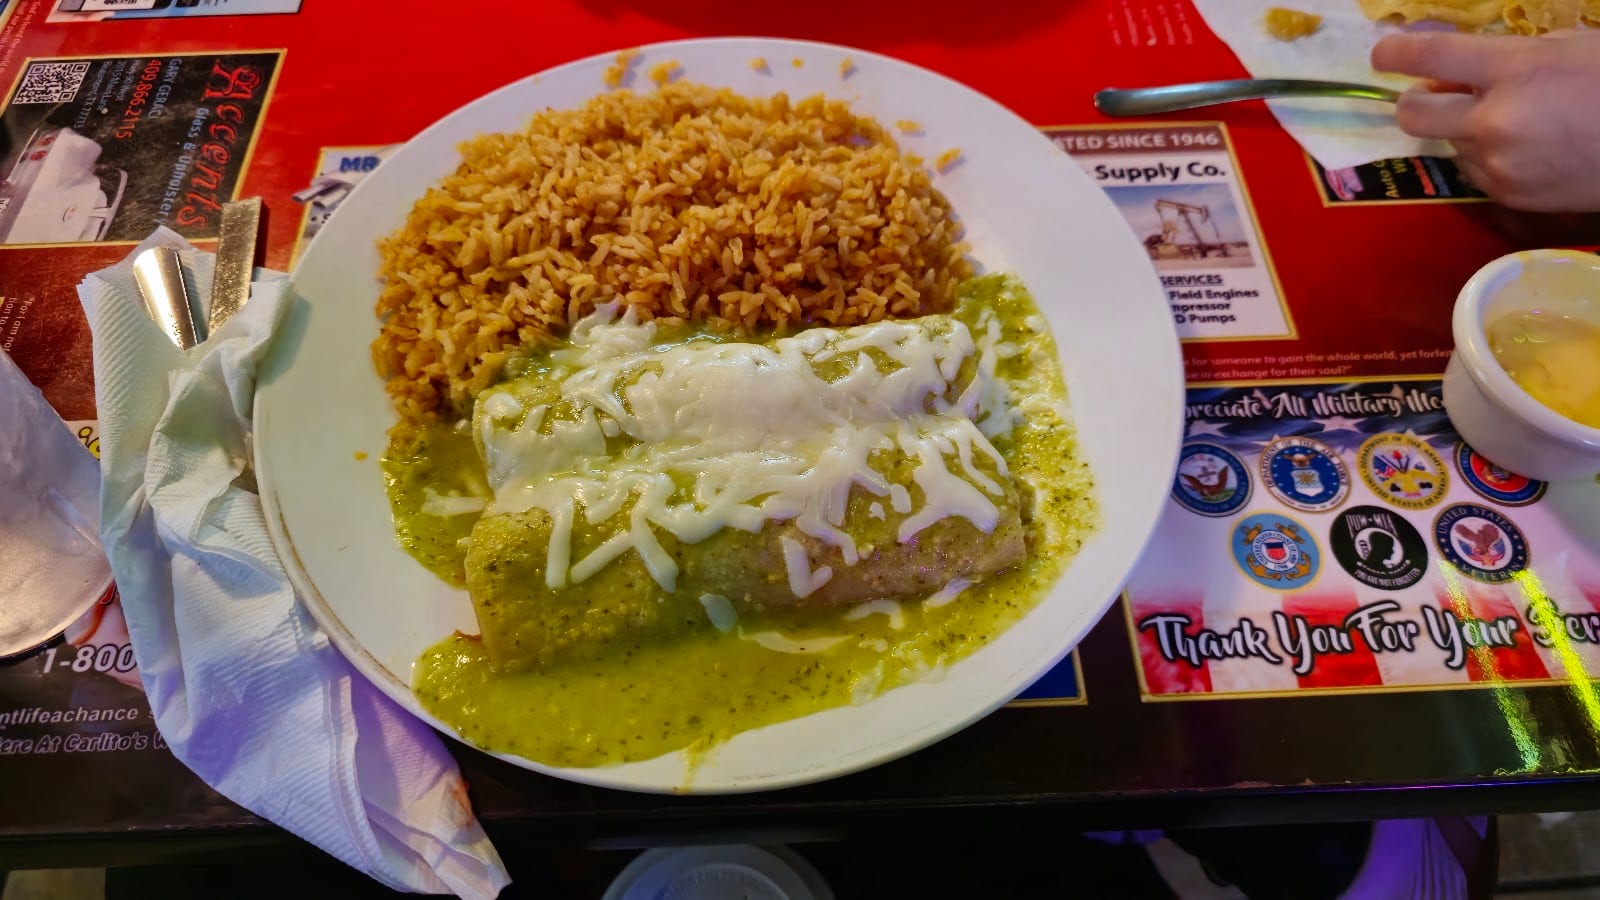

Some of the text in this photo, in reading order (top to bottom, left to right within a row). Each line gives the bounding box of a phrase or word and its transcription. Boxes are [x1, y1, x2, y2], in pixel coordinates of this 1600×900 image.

[116, 59, 162, 139] 409.866.2115
[147, 58, 182, 119] GARY GERACI
[176, 58, 262, 229] Accents
[1106, 133, 1165, 149] SINCE
[1169, 131, 1220, 148] 1946
[153, 107, 209, 225] Glass & Upholstery
[1094, 161, 1226, 183] Supply Co.
[1205, 289, 1259, 300] Engines
[10, 320, 21, 335] am
[1189, 314, 1237, 325] Pumps
[1211, 357, 1262, 366] someone
[1264, 355, 1276, 364] to
[1278, 356, 1303, 366] gain
[1305, 353, 1322, 363] the
[1327, 351, 1360, 361] whole
[1400, 350, 1417, 362] yet
[1214, 369, 1268, 380] exchange
[1270, 367, 1287, 377] for
[1289, 366, 1316, 376] their
[1270, 392, 1307, 418] All
[1312, 391, 1402, 418] Military
[1438, 507, 1512, 534] UNITED STATES
[1139, 611, 1283, 668] Thank
[1272, 610, 1354, 677] You
[1345, 600, 1420, 653] For
[1421, 604, 1520, 671] Your
[40, 643, 137, 673] 1-800
[0, 736, 33, 755] ere
[34, 734, 62, 754] At
[63, 731, 149, 753] Carlito's
